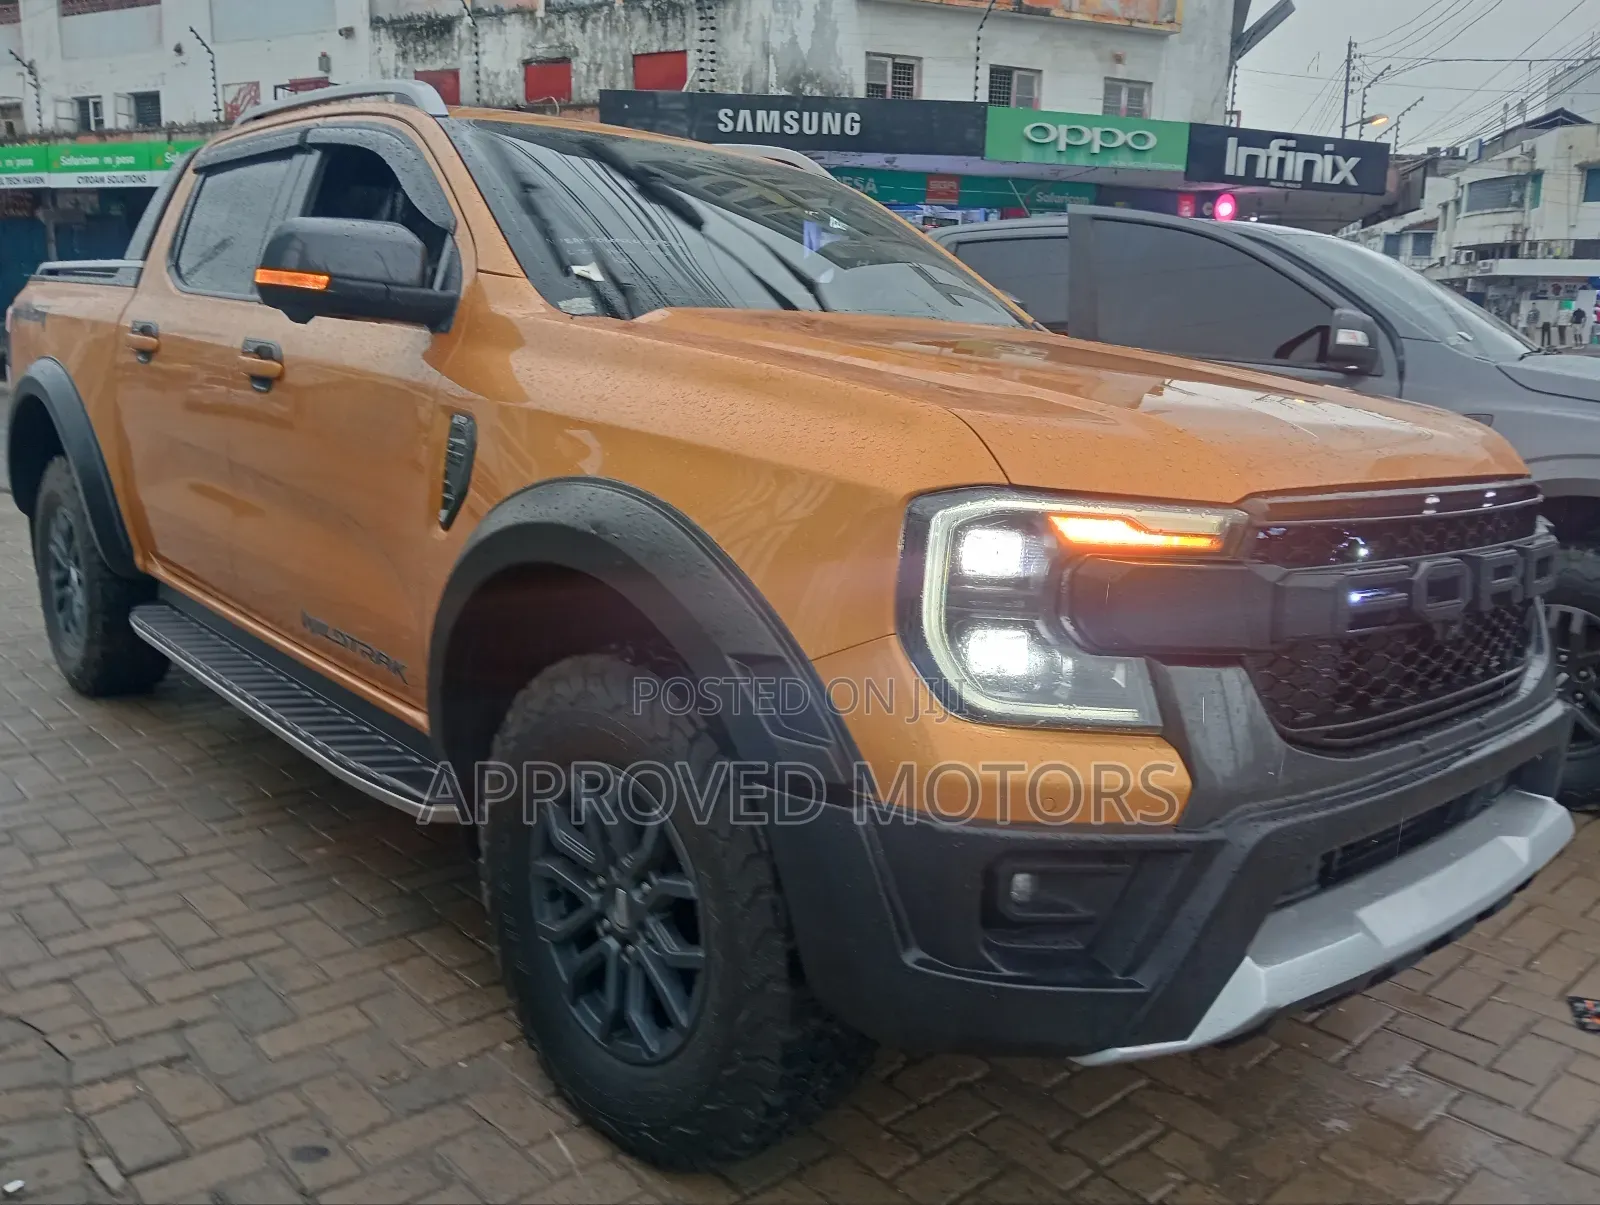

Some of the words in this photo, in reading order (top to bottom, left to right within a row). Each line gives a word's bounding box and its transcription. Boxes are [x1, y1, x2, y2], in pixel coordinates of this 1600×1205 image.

[717, 108, 861, 136] SAMSUNG
[1023, 122, 1158, 154] oppo
[1223, 136, 1362, 187] Infinix
